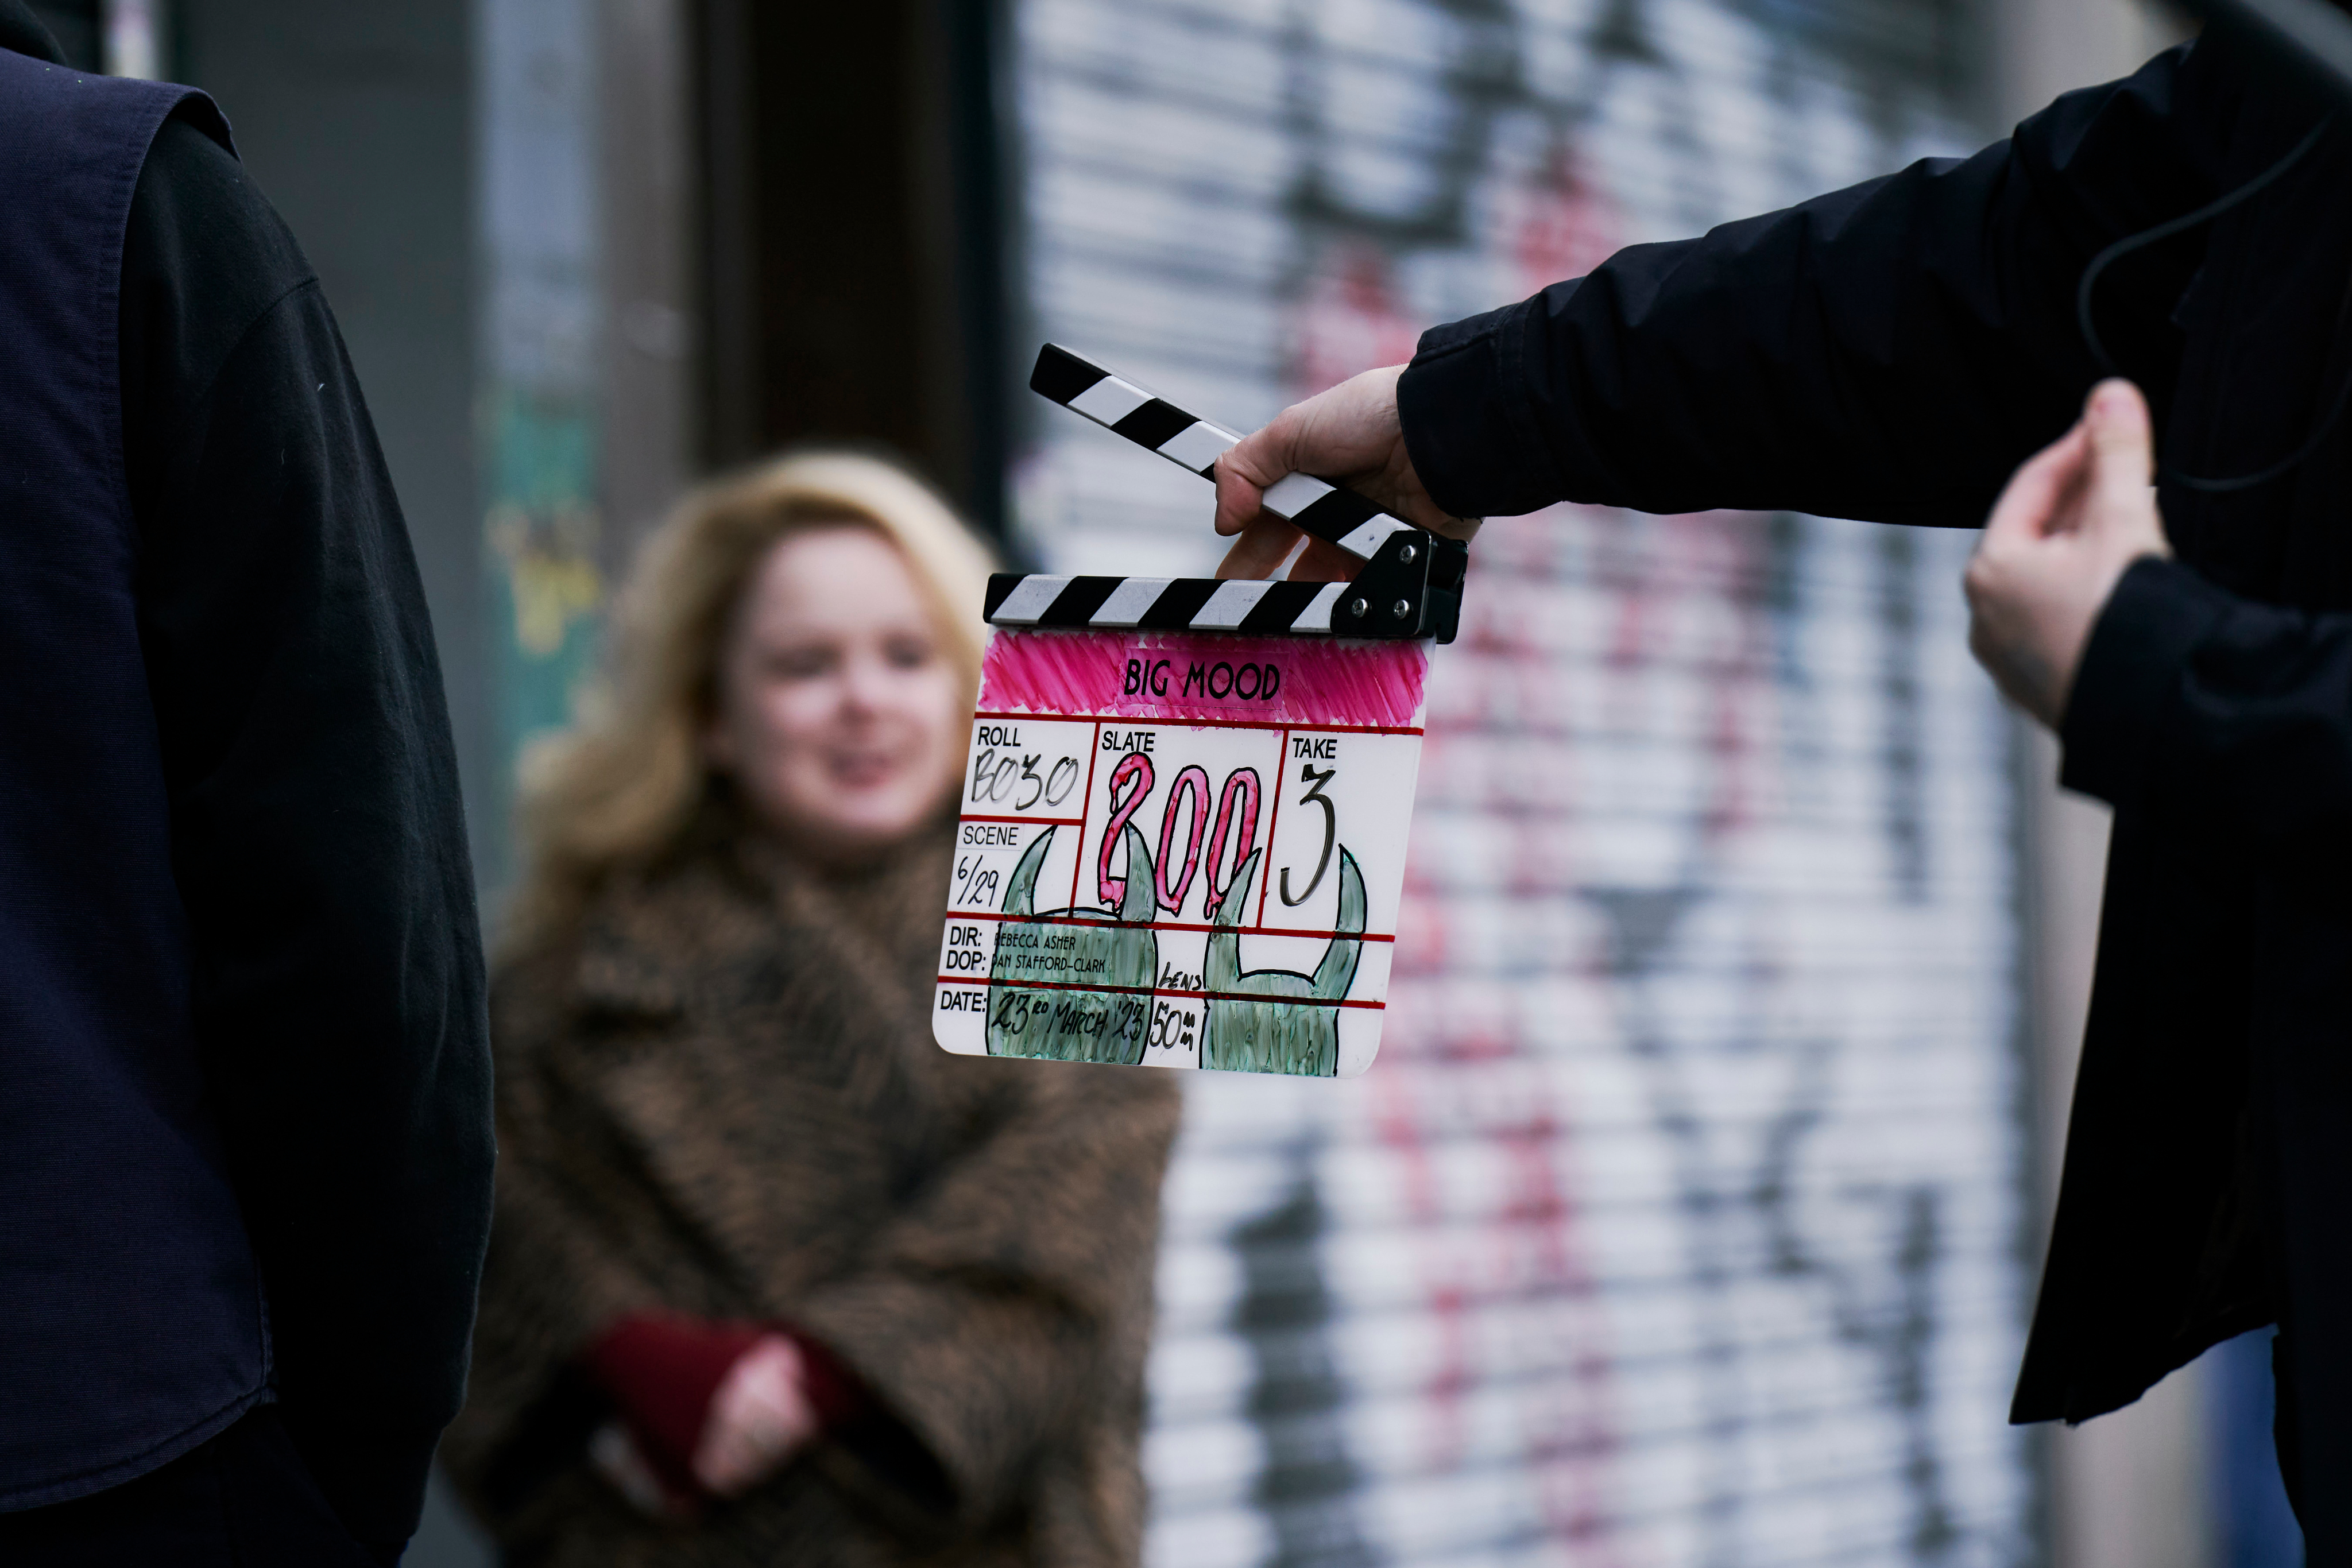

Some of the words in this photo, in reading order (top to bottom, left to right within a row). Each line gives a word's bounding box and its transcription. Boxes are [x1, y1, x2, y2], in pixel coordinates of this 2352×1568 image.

[1124, 659, 1170, 697] BIG
[1182, 661, 1281, 701] MOOD
[977, 726, 1021, 747] ROLL
[1101, 731, 1156, 752] SLATE
[1293, 738, 1337, 759] TAKE
[963, 826, 1019, 845] SCENE
[1279, 764, 1336, 907] 3
[957, 854, 999, 907] 6/29
[949, 926, 982, 947] DIR:
[1043, 935, 1076, 950] ASHER
[946, 950, 986, 971] DOP:
[992, 954, 1012, 967] DAN
[1015, 954, 1106, 973] STAFFORD-CLARK
[1158, 961, 1202, 991] LENS
[940, 990, 987, 1012] DATE:
[1046, 1001, 1109, 1039] MARCH
